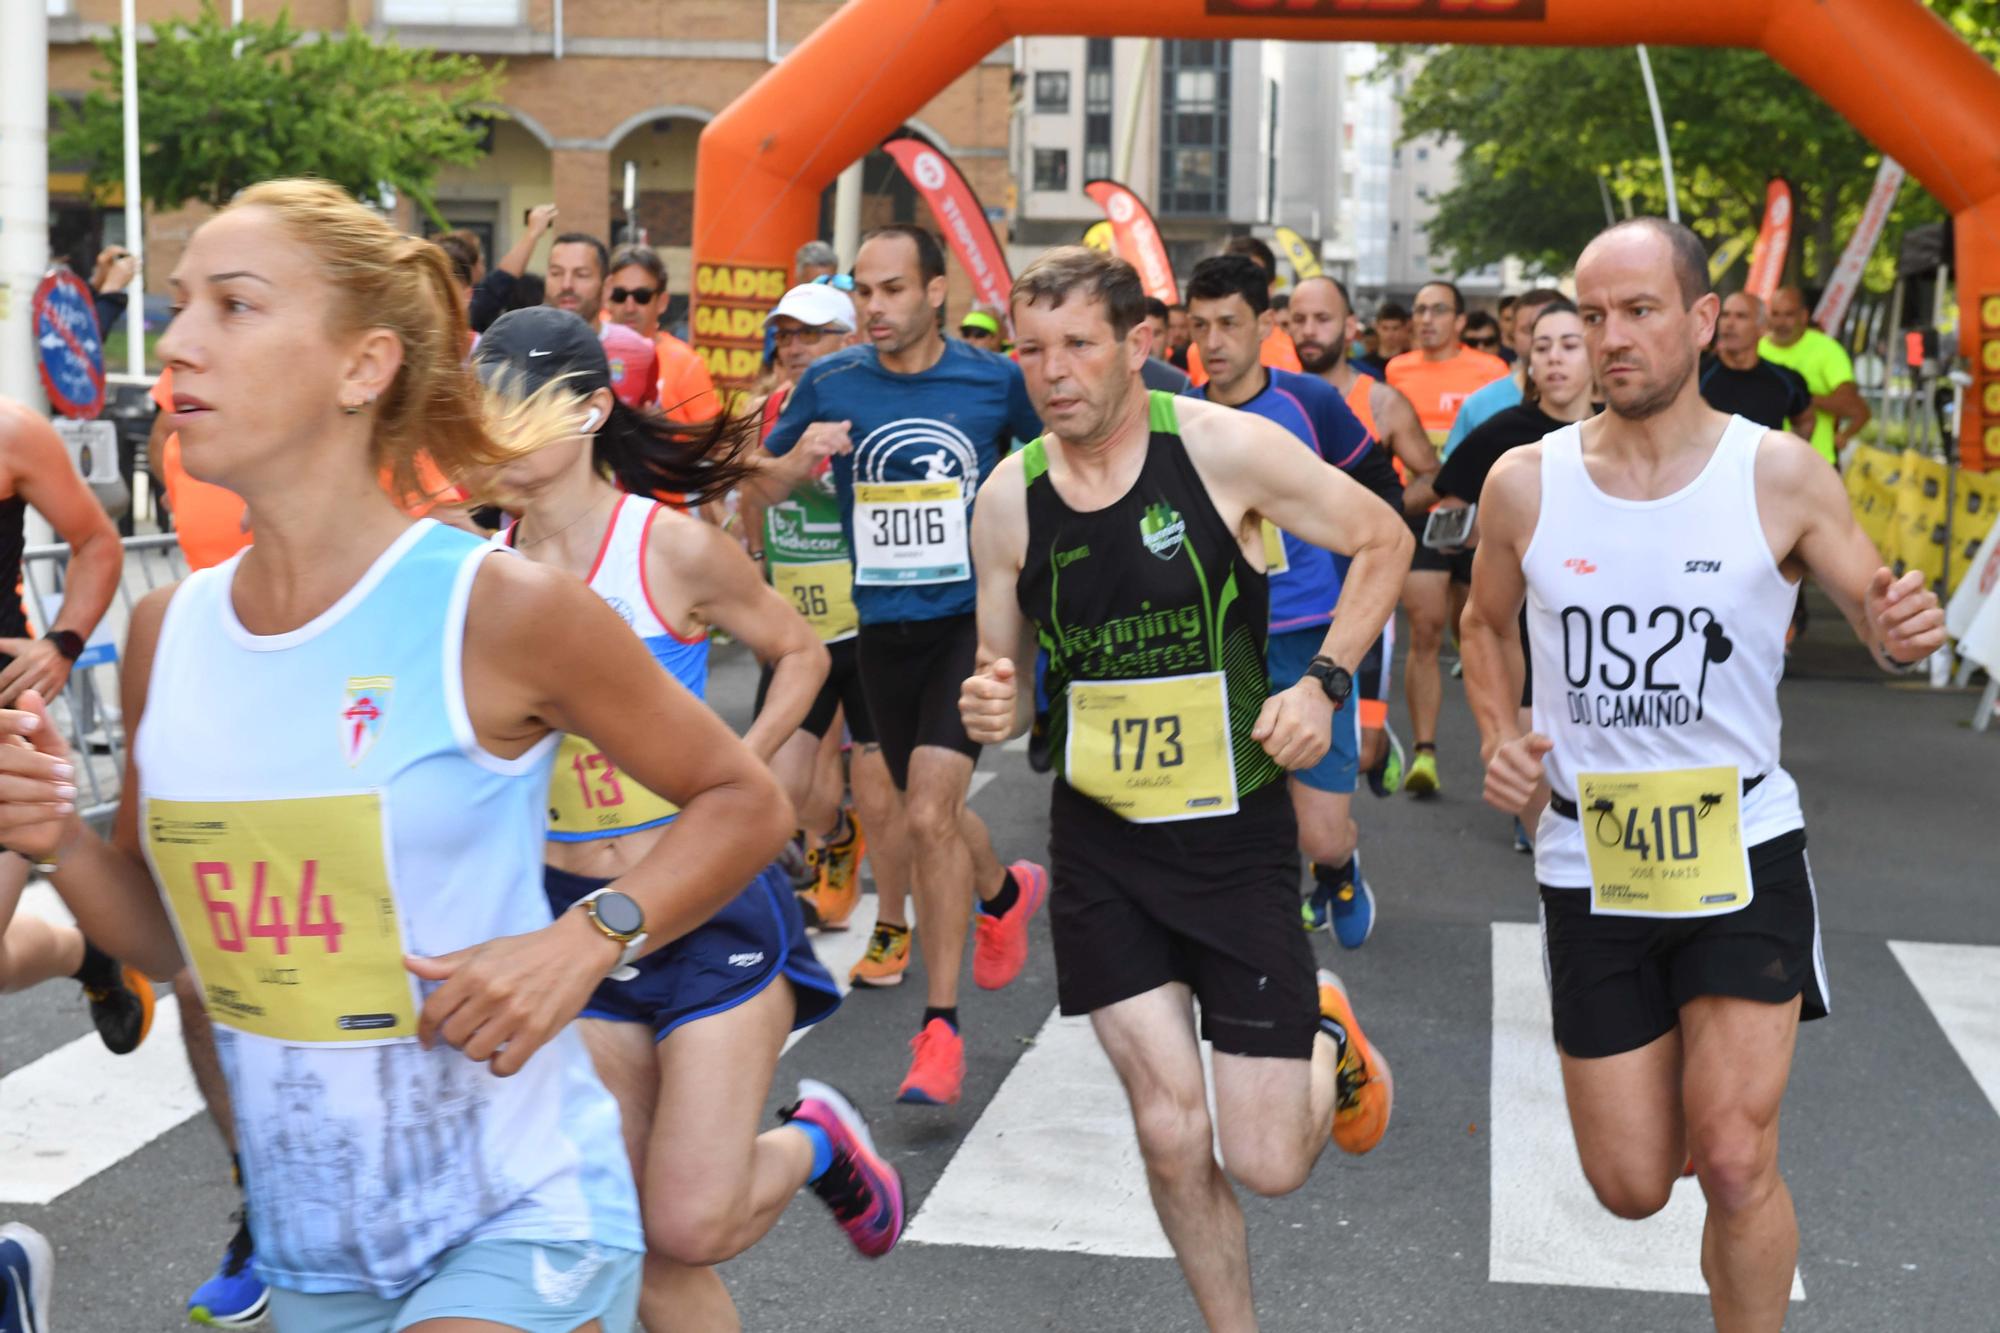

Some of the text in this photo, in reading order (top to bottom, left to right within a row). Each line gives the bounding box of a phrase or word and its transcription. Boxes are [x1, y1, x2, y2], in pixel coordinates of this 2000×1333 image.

[697, 265, 786, 298] GADIS
[695, 306, 766, 338] GADI
[872, 508, 945, 547] 3016
[793, 584, 828, 616] 36
[1063, 600, 1200, 657] Running
[1567, 689, 1690, 728] DO CAMIÑO
[1111, 714, 1185, 772] 173
[573, 753, 625, 809] 13
[1623, 804, 1699, 863] 410
[193, 859, 345, 956] 644
